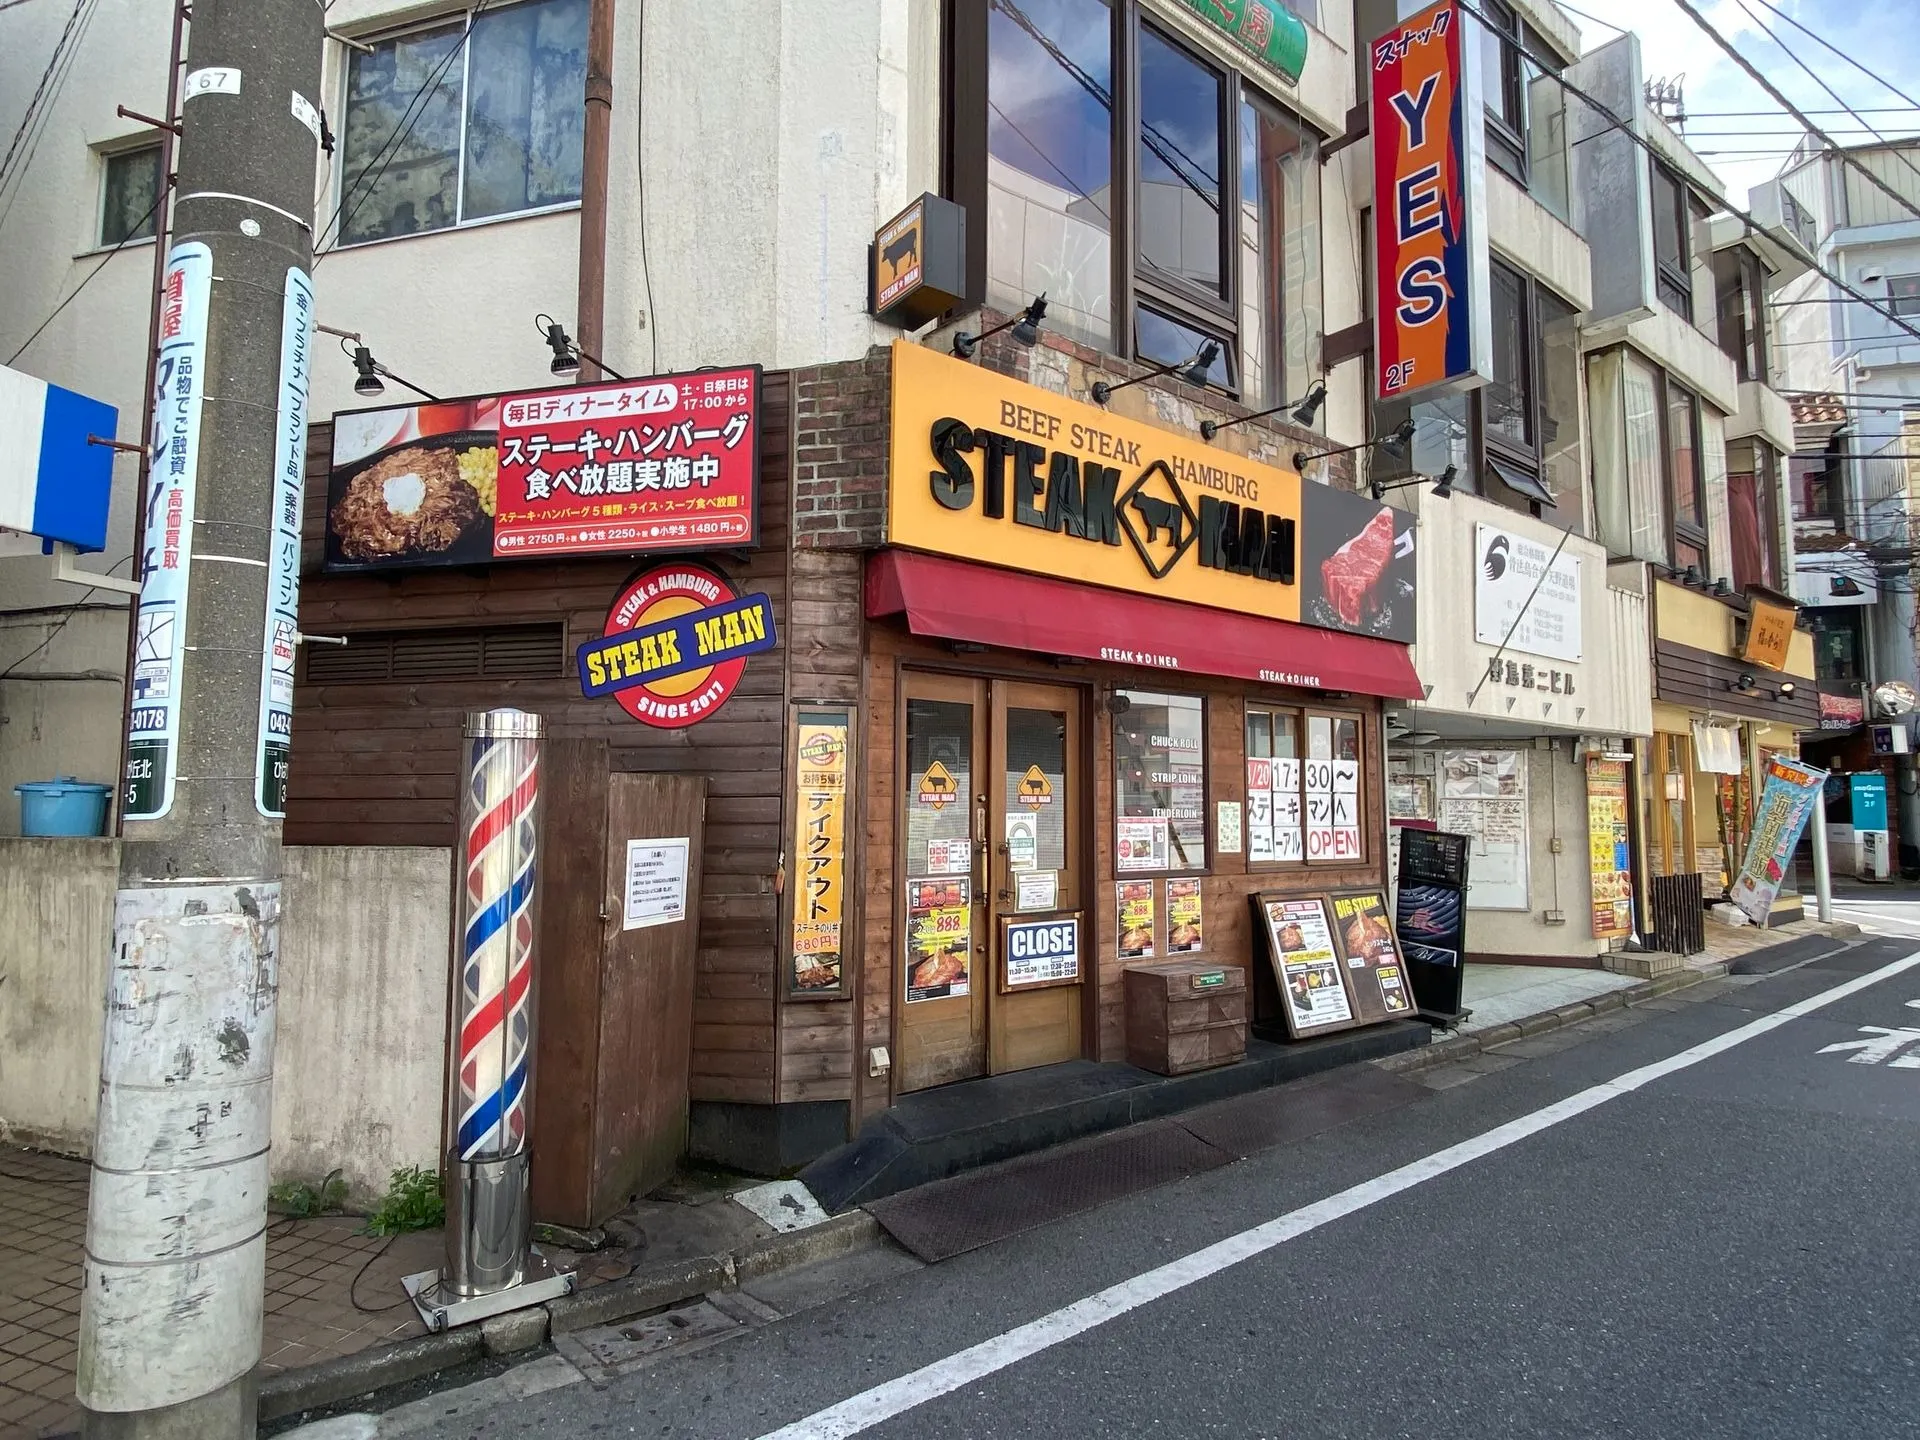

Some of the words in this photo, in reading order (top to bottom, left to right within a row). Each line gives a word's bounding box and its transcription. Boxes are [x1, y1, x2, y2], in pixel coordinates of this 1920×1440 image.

[1376, 9, 1452, 71] スナック
[200, 72, 227, 89] 67
[1388, 71, 1447, 328] YES
[880, 287, 898, 303] STEAK
[904, 267, 919, 286] MAN
[681, 378, 749, 397] 土・日祭日は
[1386, 359, 1416, 391] 2F
[508, 389, 670, 422] 毎日ディナータイム
[501, 413, 750, 467] ステーキ・ハンバーグ
[1000, 400, 1062, 440] BEEF
[1071, 423, 1141, 467] STEAK
[1172, 455, 1259, 502] HAMBURG
[525, 454, 719, 501] 食べ放題実施中
[929, 416, 1123, 547] STEAK
[1198, 495, 1296, 586] MAN
[509, 537, 525, 546] 男性
[588, 531, 606, 541] 女性
[660, 526, 687, 536] 小学生
[280, 542, 295, 605] パソコン
[616, 588, 651, 627] STEAK
[647, 582, 660, 595] &
[658, 574, 720, 601] HAMBURG
[586, 630, 682, 687] STEAK
[694, 605, 766, 657] MAN
[637, 697, 689, 718] SINCE
[690, 681, 725, 713] 2017
[1821, 720, 1851, 729] カルビ
[1151, 735, 1179, 749] CHUCK
[1180, 737, 1199, 750] ROLL
[803, 773, 843, 785] お持ち帰り
[1151, 772, 1176, 784] STRIP
[1178, 773, 1197, 784] LOIN
[921, 794, 940, 802] STEAK
[941, 793, 955, 801] MAN
[1151, 808, 1197, 819] TENDERLOIN
[807, 792, 833, 920] テイクアウト
[1309, 830, 1358, 855] OPEN
[1335, 899, 1353, 919] BIG
[1352, 896, 1379, 913] STEAK
[795, 935, 832, 951] 680円
[1012, 926, 1073, 957] CLOSE
